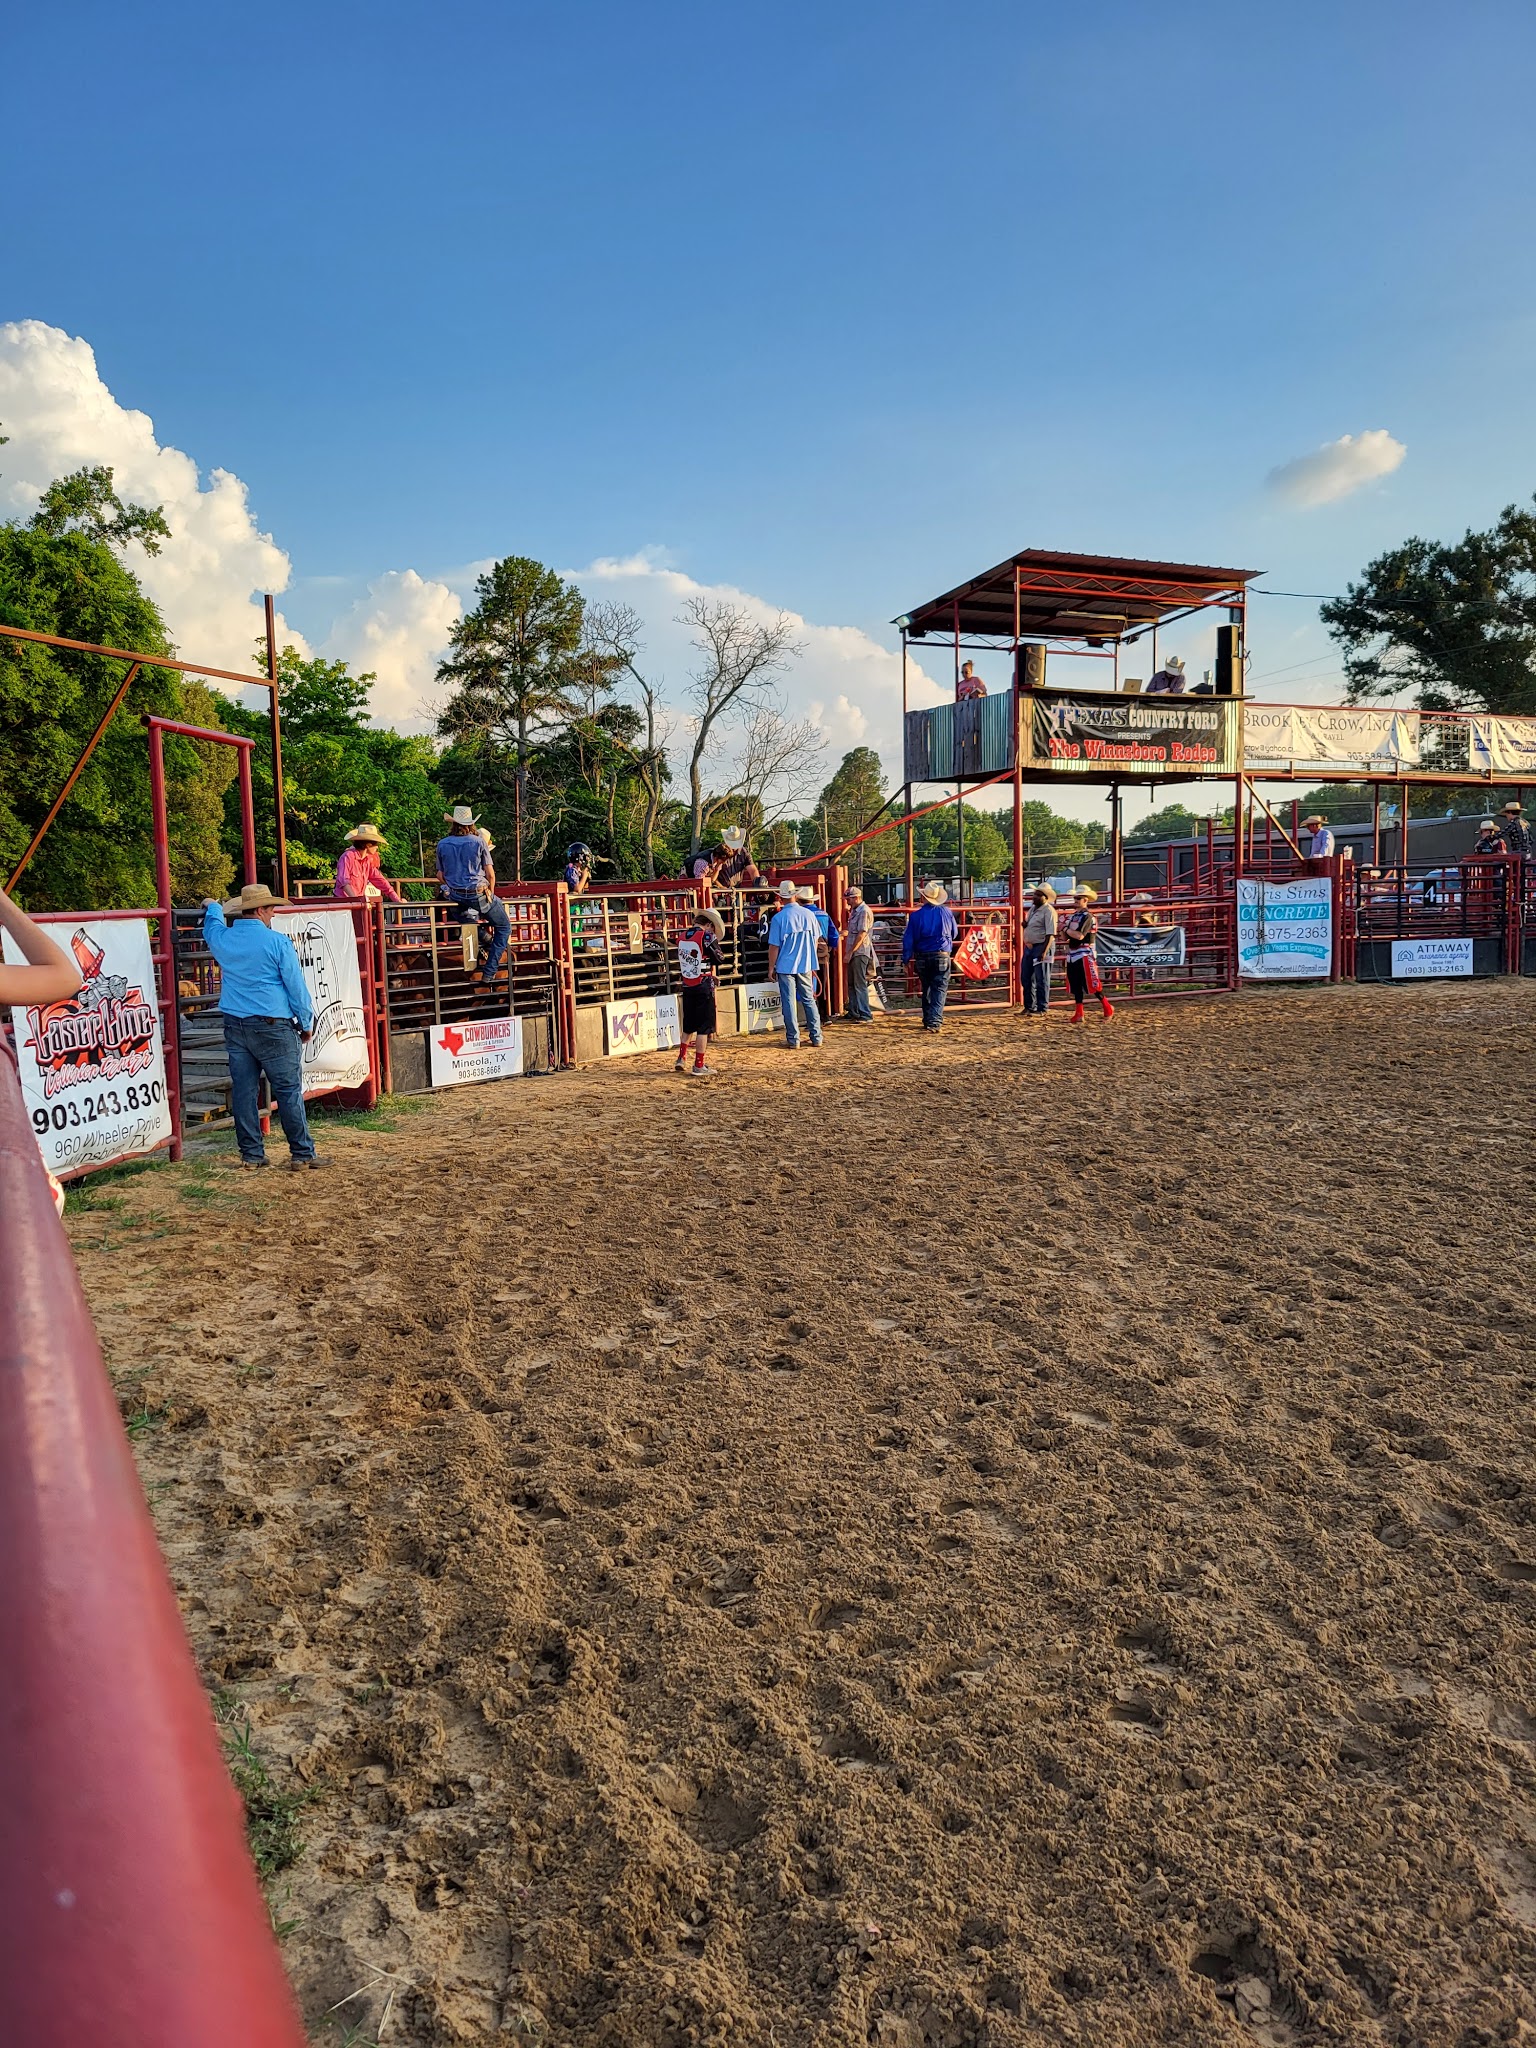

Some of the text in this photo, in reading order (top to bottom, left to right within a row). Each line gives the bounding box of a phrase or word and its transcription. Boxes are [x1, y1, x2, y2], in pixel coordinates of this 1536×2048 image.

[1129, 708, 1186, 729] COUNTRY
[1187, 711, 1218, 730] FORD
[1117, 732, 1152, 740] PRESENTS
[1049, 738, 1217, 763] The Winnsboro Rodeo
[1286, 886, 1326, 900] Sims
[1424, 886, 1435, 902] 4
[1241, 905, 1328, 920] CONCRETE
[760, 914, 769, 935] 3
[632, 922, 641, 945] 2
[1240, 926, 1328, 940] 903-975-2363
[466, 934, 477, 962] 1
[1271, 944, 1289, 952] Years
[1290, 943, 1323, 953] Experience
[1417, 943, 1470, 953] ATTAWAY
[1104, 955, 1174, 963] 903-767-5395
[1405, 965, 1464, 975] (903) 383-2163
[27, 997, 157, 1065] Laser Line
[612, 1012, 643, 1039] KT
[452, 1053, 507, 1069] Mineola, TX
[32, 1077, 167, 1135] 903.243.8301
[55, 1115, 161, 1159] 960 Wheeler Drive
[127, 1133, 151, 1149] TX
